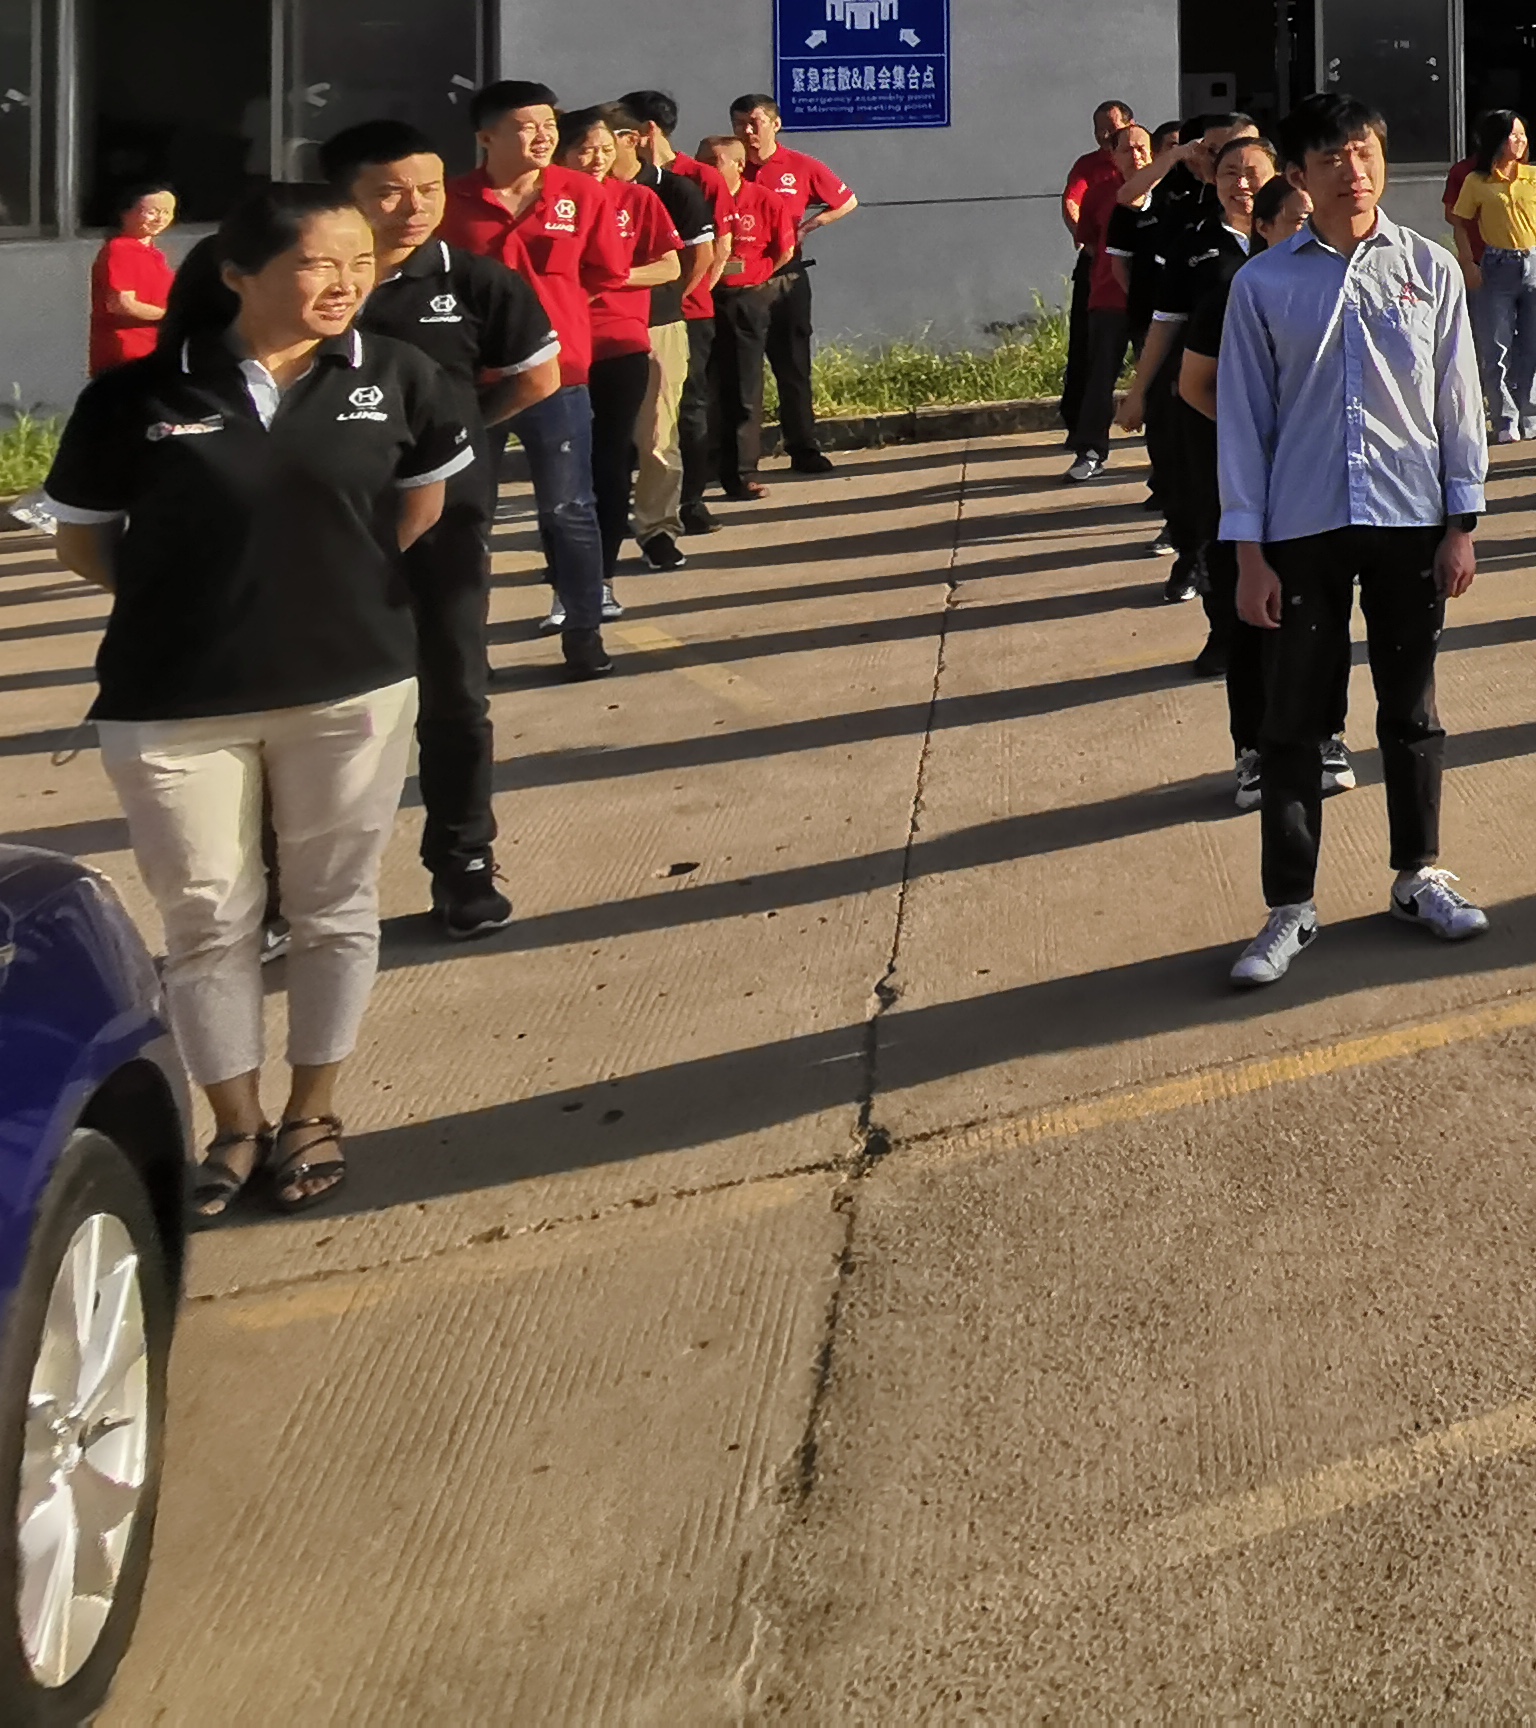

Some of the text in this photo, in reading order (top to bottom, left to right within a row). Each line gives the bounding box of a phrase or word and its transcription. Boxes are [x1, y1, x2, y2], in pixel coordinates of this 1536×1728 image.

[791, 96, 851, 105] Emergency
[907, 92, 936, 102] point
[806, 105, 855, 113] Morning
[904, 102, 932, 112] point
